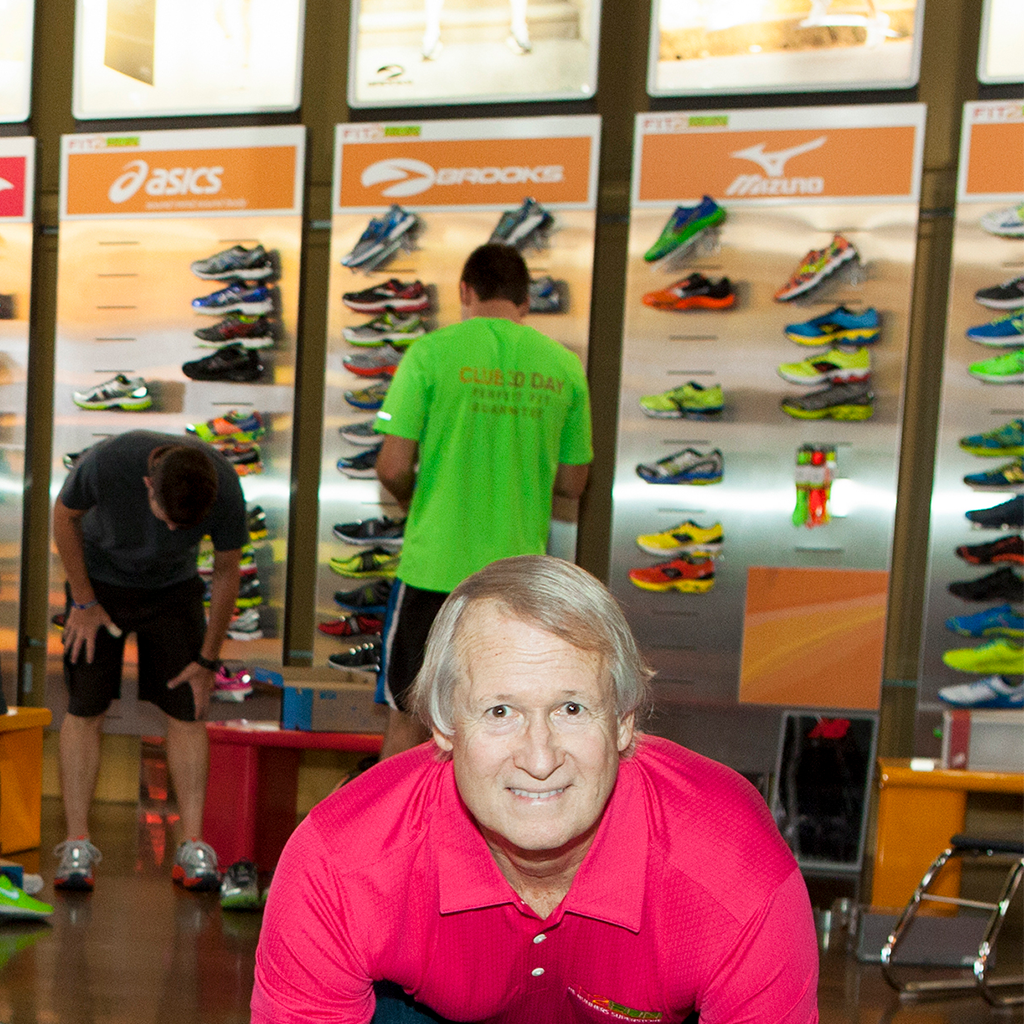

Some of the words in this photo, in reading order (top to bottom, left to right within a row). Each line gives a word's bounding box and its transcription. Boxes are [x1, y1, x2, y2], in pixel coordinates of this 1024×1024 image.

[434, 165, 564, 185] BROOKS
[460, 367, 503, 386] CLUB
[531, 371, 565, 394] DAY
